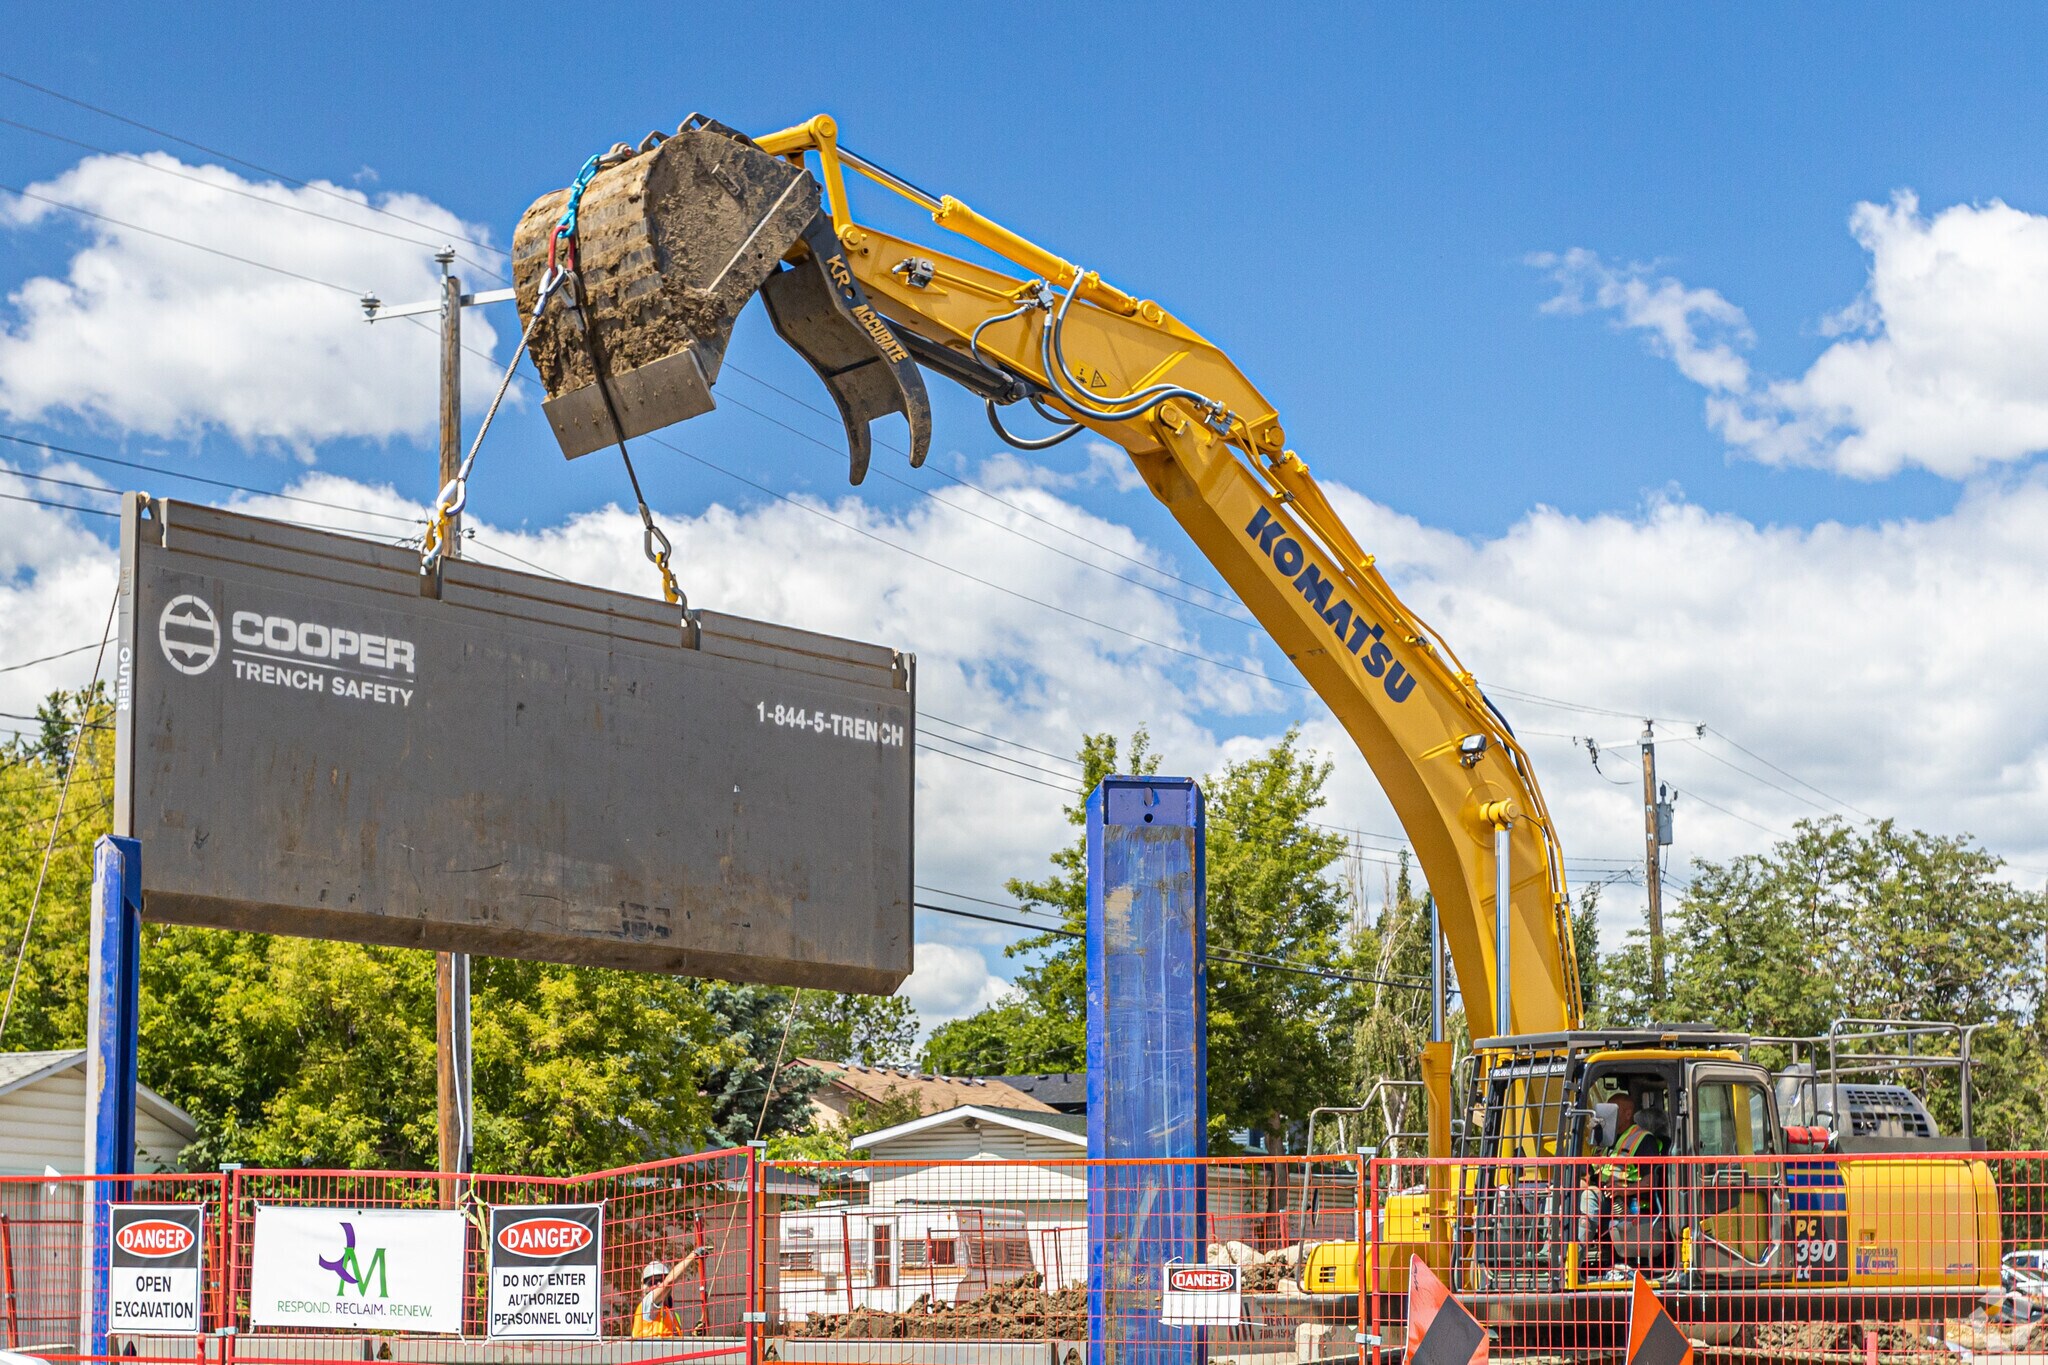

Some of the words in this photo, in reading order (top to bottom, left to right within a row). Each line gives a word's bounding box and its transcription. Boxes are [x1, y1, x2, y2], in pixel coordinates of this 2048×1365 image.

[826, 254, 851, 289] KR
[851, 304, 909, 364] ACCURATE
[1245, 505, 1417, 703] KOMATSU
[232, 611, 415, 673] COOPER
[118, 646, 131, 711] OUTER
[232, 659, 324, 692] TRENCH
[331, 676, 414, 706] SAFETY
[757, 701, 904, 746] 1-844-5-TRENCH
[507, 1228, 582, 1249] DANGER
[1796, 1220, 1817, 1237] PC
[123, 1229, 186, 1249] DANGER
[1797, 1239, 1837, 1262] 390
[503, 1275, 519, 1287] DO
[523, 1274, 544, 1287] NOT
[548, 1273, 586, 1286] ENTER
[1175, 1274, 1230, 1287] DANGER
[1797, 1265, 1812, 1279] LC
[136, 1276, 172, 1292] OPEN
[115, 1301, 193, 1318] EXCAVATION
[277, 1300, 332, 1314] RESPOND.
[335, 1302, 386, 1316] RECLAIM.
[390, 1304, 433, 1317] RENEW.
[508, 1293, 580, 1306] AUTHORIZED
[494, 1312, 561, 1325] PERSONNEL
[565, 1312, 594, 1324] ONLY
